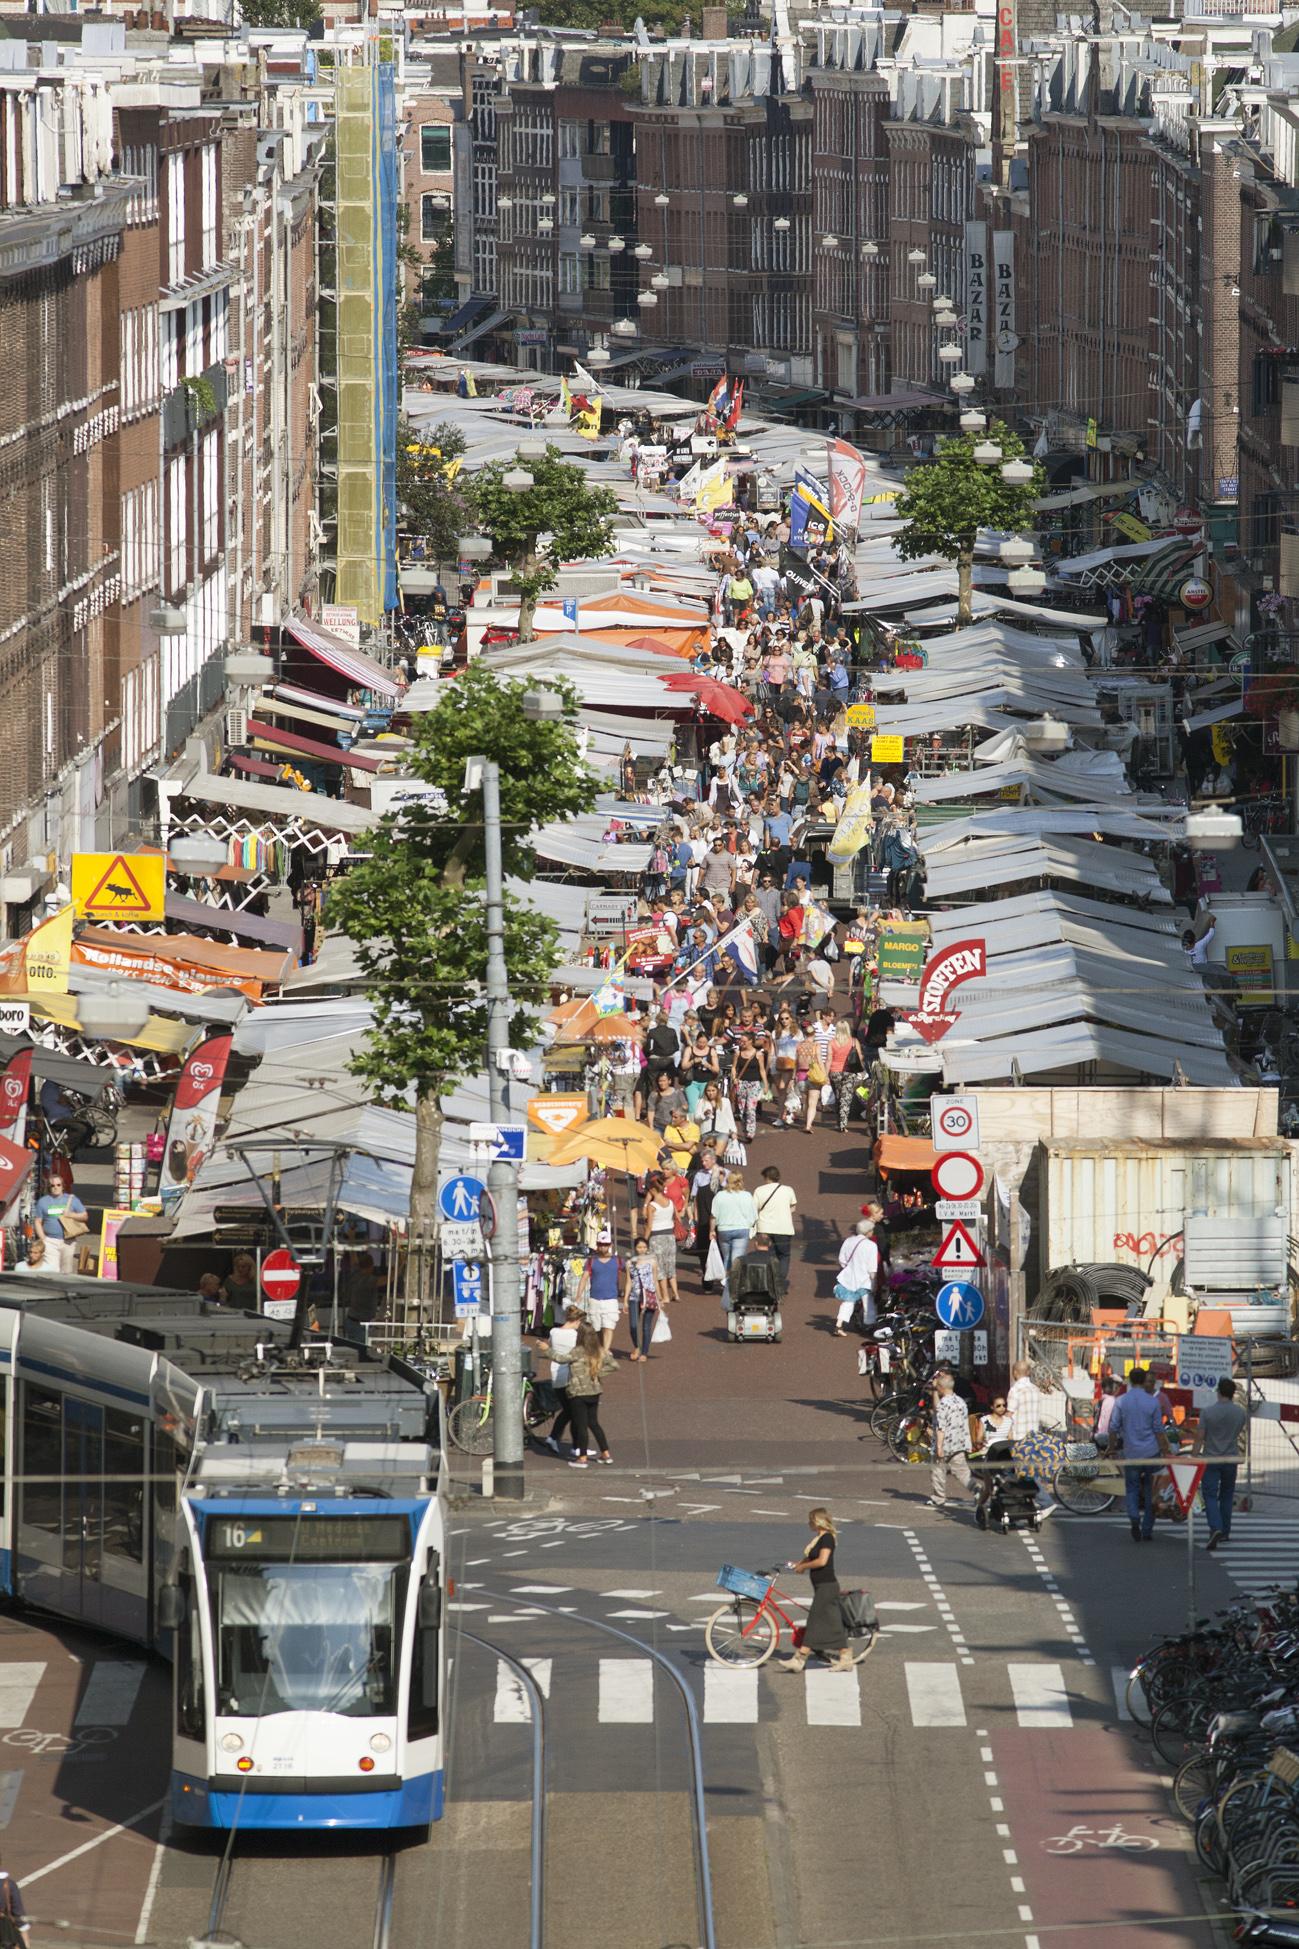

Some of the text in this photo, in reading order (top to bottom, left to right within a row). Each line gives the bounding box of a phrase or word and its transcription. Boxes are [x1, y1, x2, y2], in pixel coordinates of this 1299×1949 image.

[969, 253, 984, 341] BAZAR
[884, 941, 919, 951] MARGO
[84, 948, 173, 974] Hollandse
[882, 961, 918, 970] BLOEMEN
[922, 948, 982, 1013] STOFFEN
[946, 1115, 966, 1128] 30
[222, 1522, 246, 1547] 16
